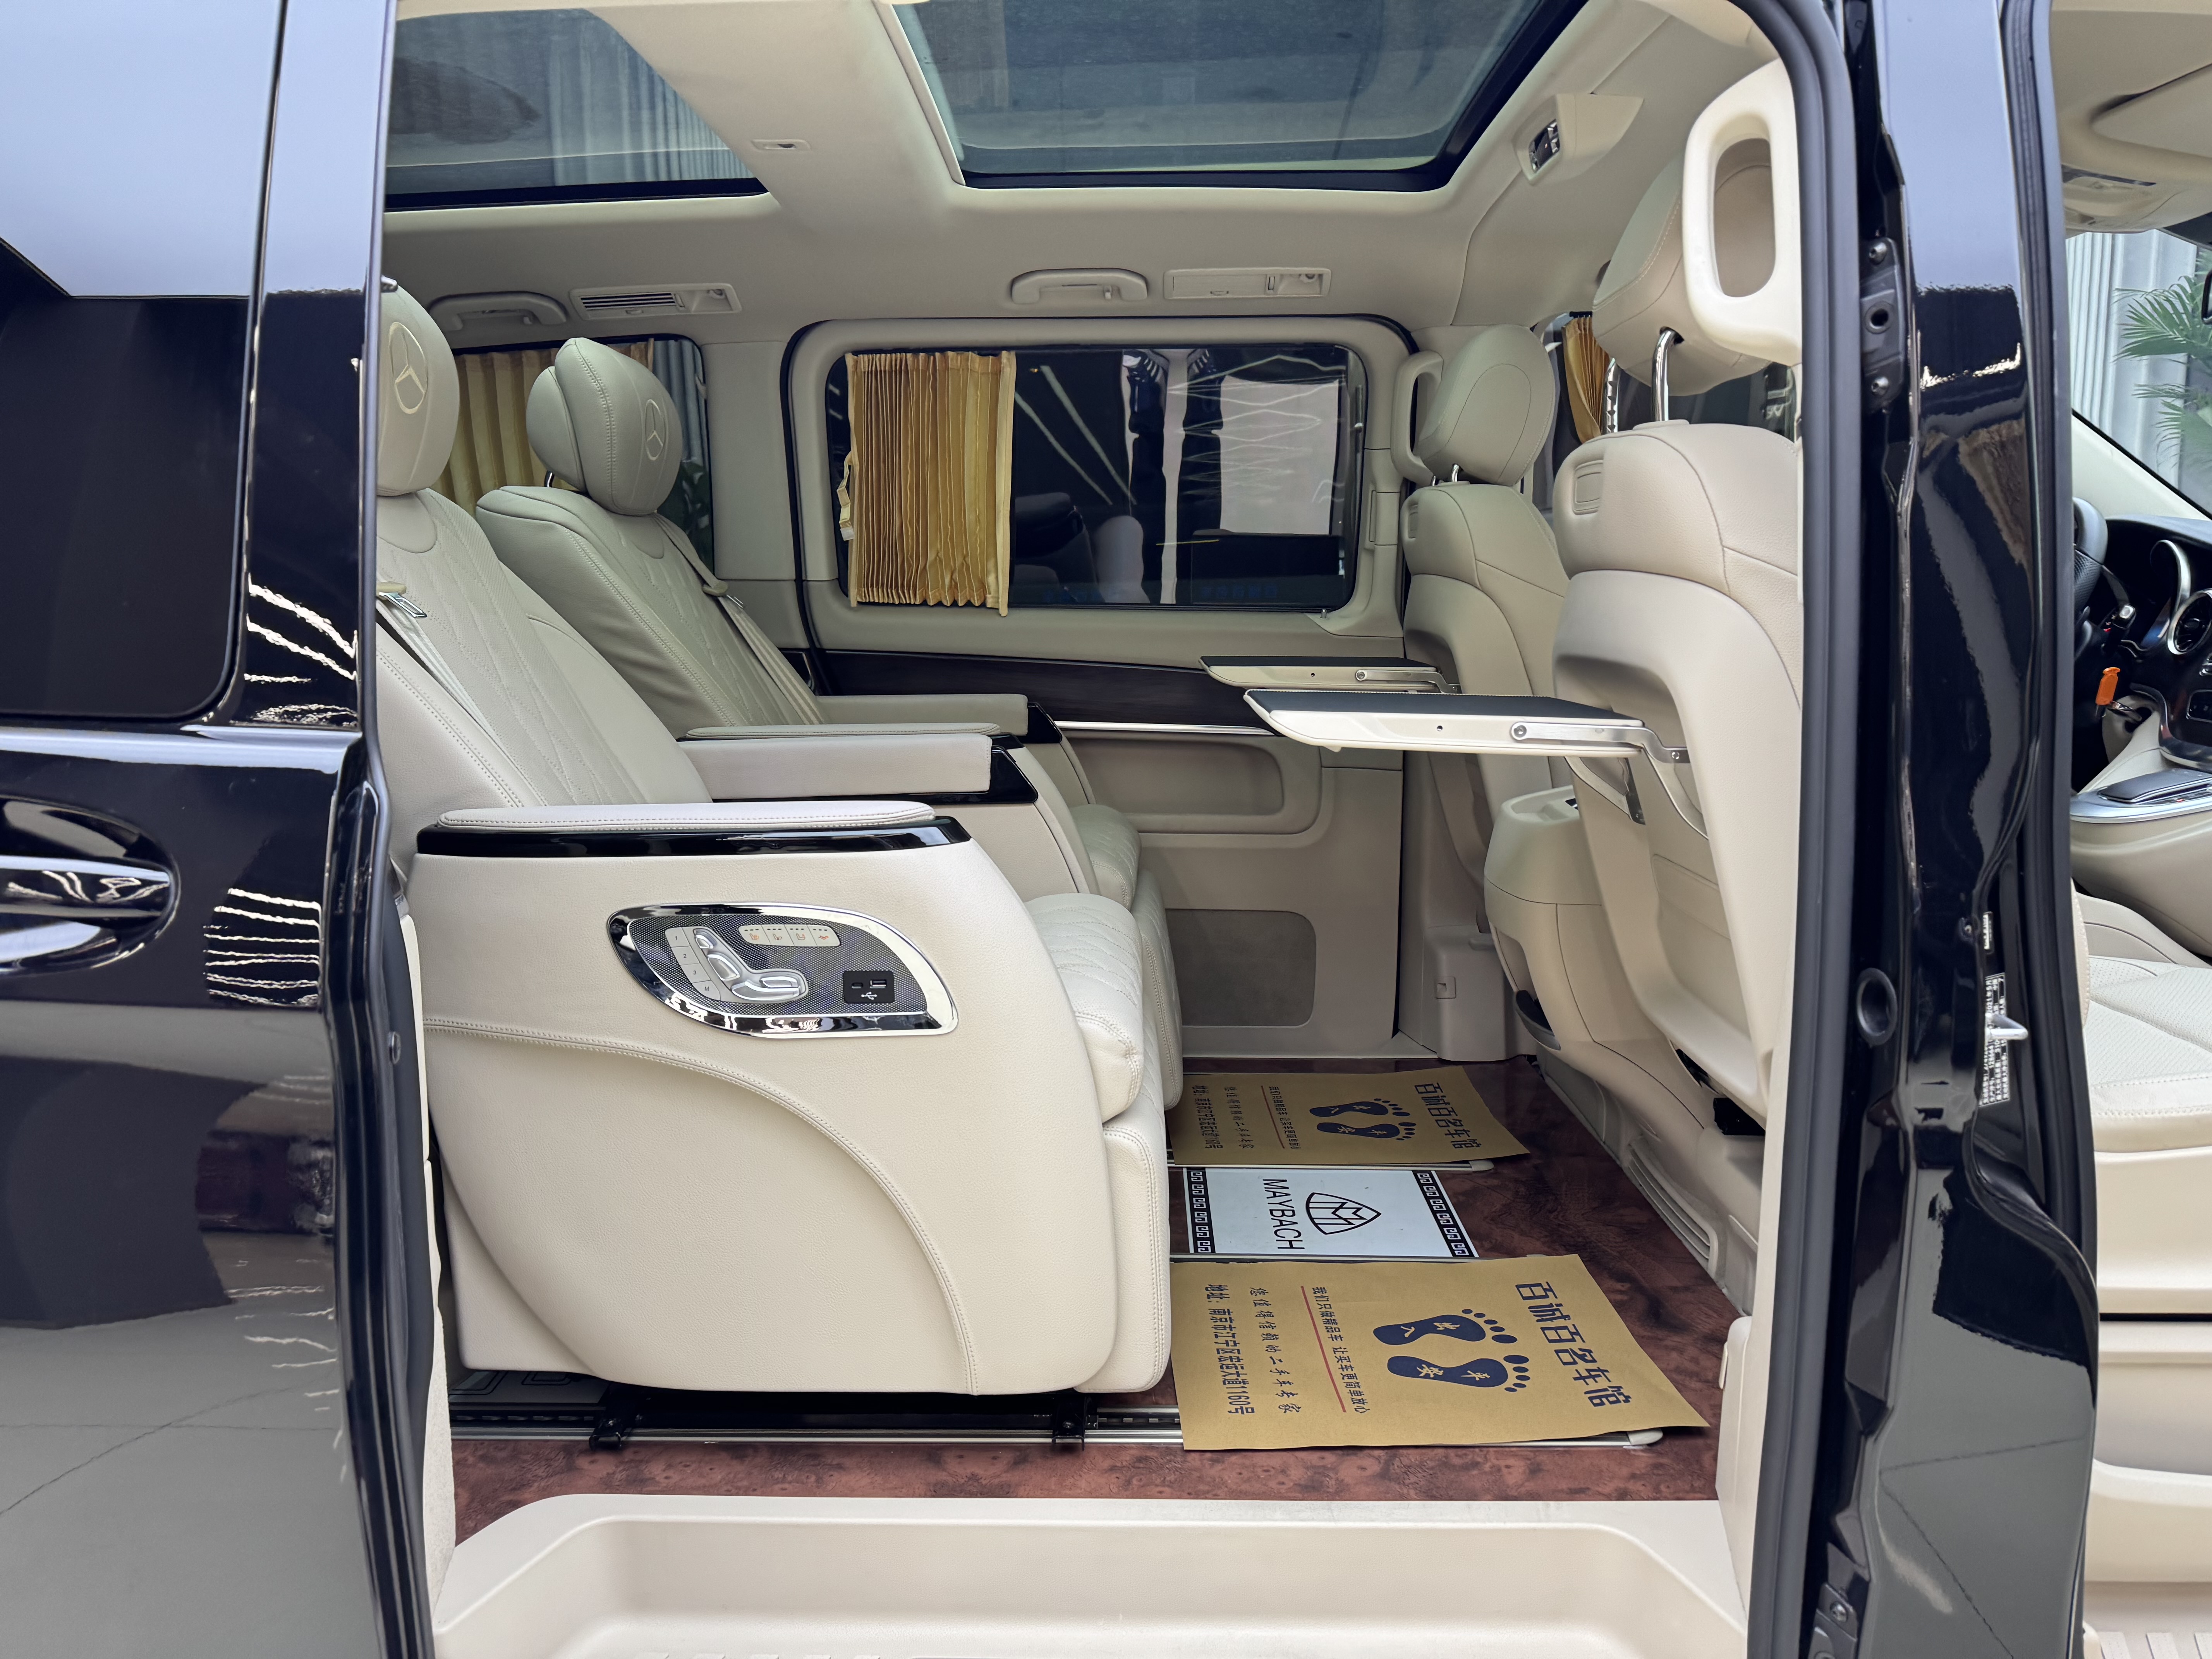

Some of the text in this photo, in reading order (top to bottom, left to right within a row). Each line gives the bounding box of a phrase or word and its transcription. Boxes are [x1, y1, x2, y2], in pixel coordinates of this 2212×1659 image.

[1414, 1082, 1482, 1149] 百诚百名车馆
[1262, 1179, 1305, 1249] MAYBACH
[1250, 1287, 1302, 1413] 您值得信赖的二手车专家
[1312, 1286, 1370, 1413] 我们只做精品车 让买车更简单放心
[1515, 1281, 1632, 1407] 百诚百名车馆
